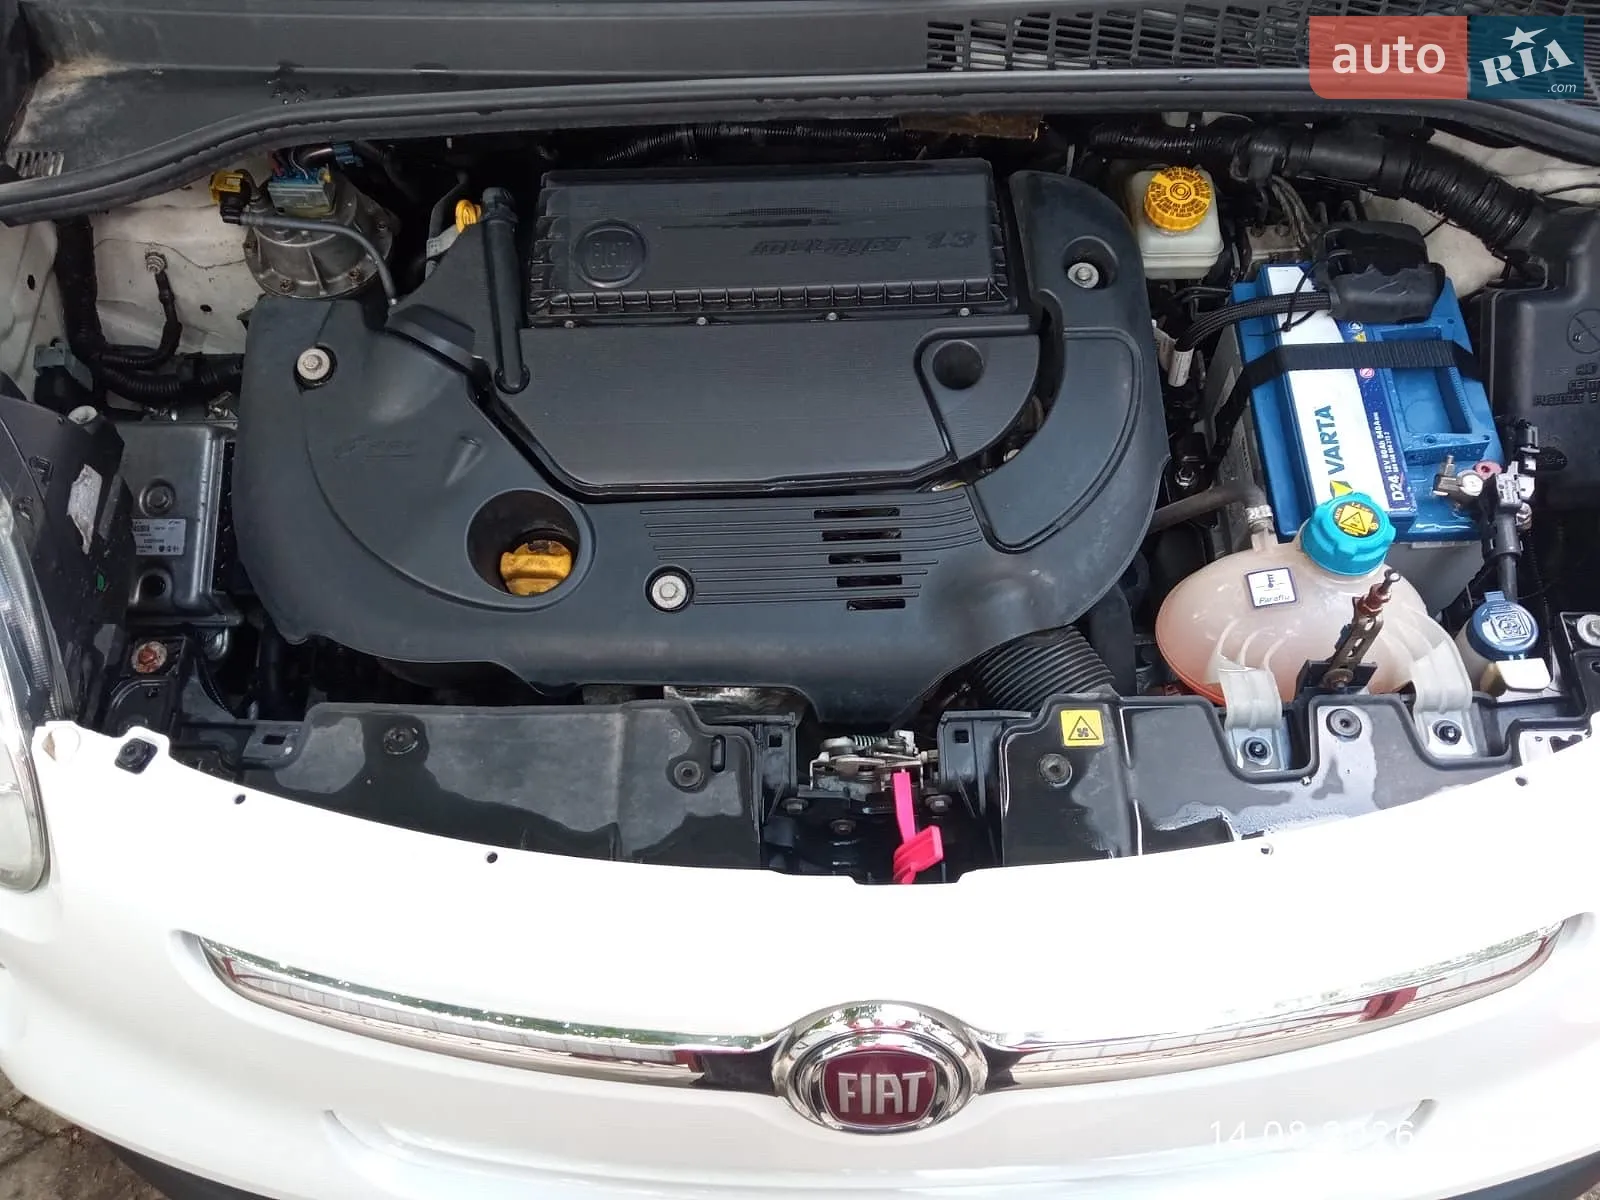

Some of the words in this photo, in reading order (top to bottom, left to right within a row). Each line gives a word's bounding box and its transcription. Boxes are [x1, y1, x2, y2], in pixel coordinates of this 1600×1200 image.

[1313, 405, 1345, 475] VARTA
[1387, 474, 1406, 501] D24
[837, 1071, 927, 1115] FIAT
